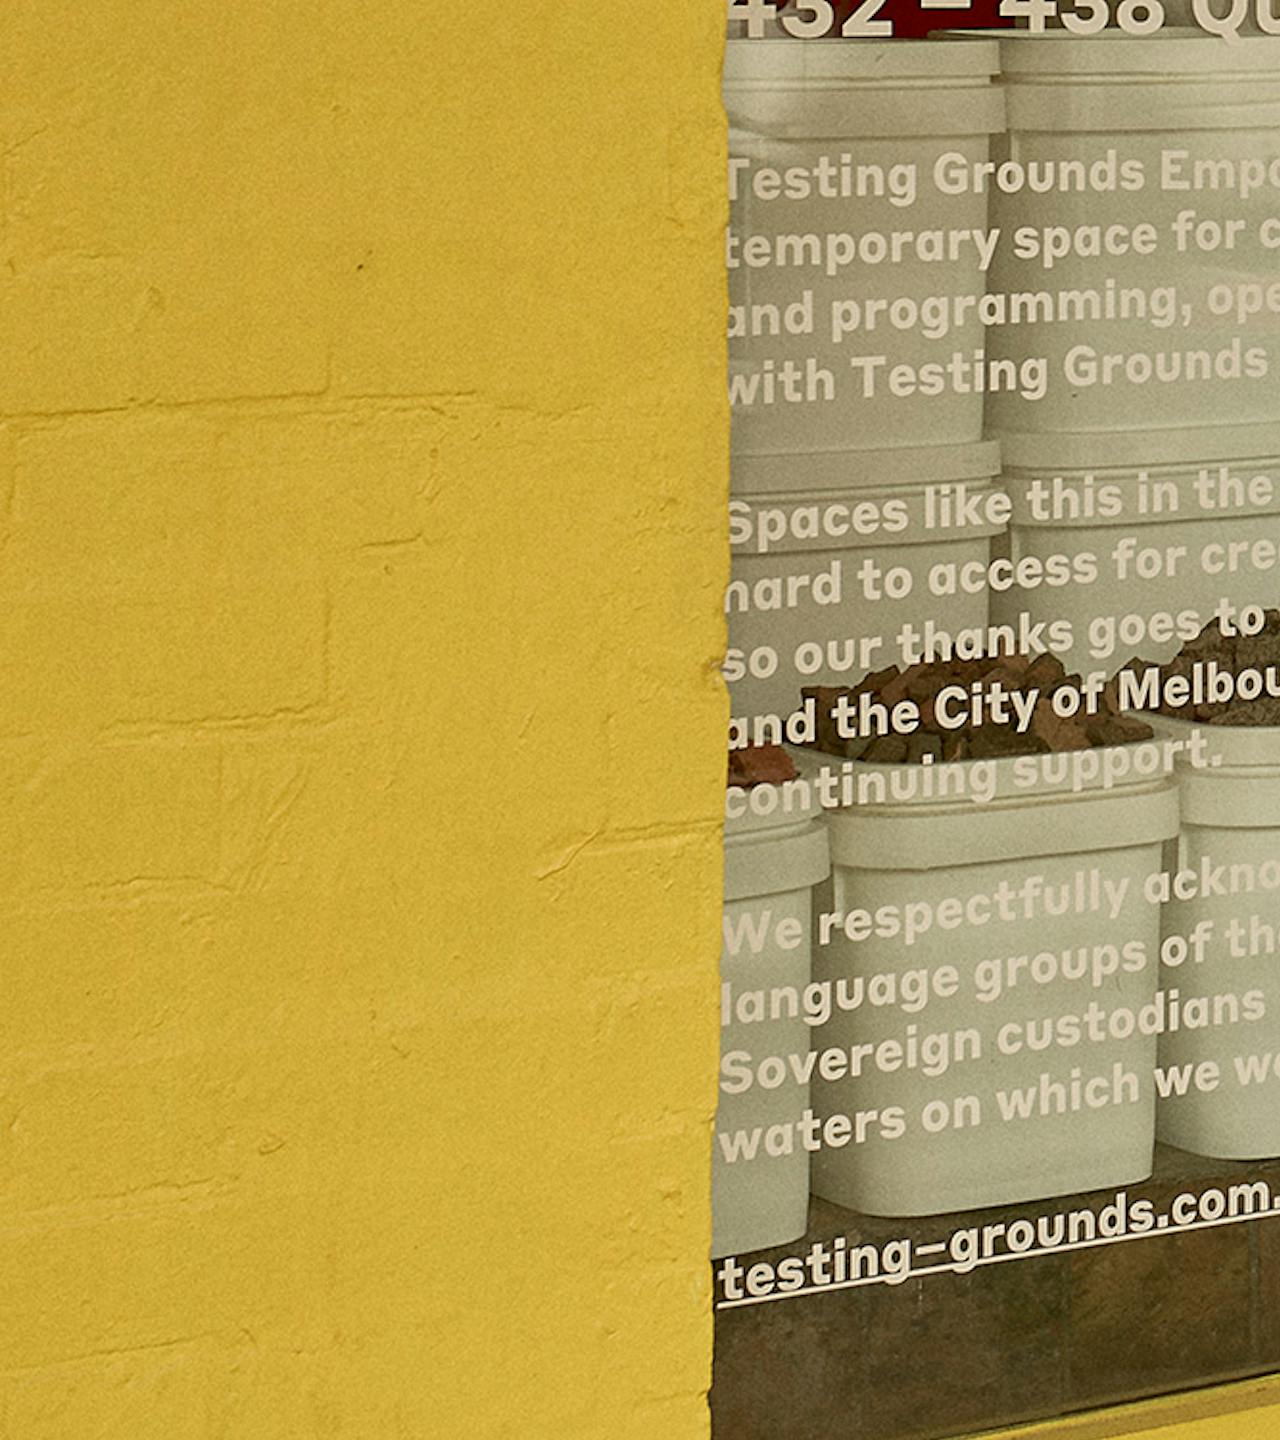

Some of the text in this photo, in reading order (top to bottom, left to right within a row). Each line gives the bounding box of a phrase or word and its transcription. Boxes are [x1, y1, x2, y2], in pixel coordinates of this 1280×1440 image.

[727, 153, 918, 207] Testing
[932, 148, 1146, 198] Grounds
[726, 224, 1000, 276] temporary
[1013, 219, 1158, 268] space
[1174, 210, 1245, 252] for
[727, 290, 814, 339] and
[831, 278, 1193, 342] programming,
[727, 357, 835, 406] with
[850, 349, 1049, 399] Testing
[1063, 336, 1268, 388] Grounds
[728, 497, 909, 553] Spaces
[923, 483, 1013, 530] like
[1026, 474, 1123, 522] this
[1138, 471, 1179, 515] in
[1192, 466, 1274, 511] the
[857, 557, 914, 601] to
[928, 548, 1098, 597] access
[1111, 537, 1187, 582] for
[722, 644, 779, 683] so
[793, 632, 884, 676] our
[896, 611, 1075, 666] thanks
[1087, 606, 1201, 658] goes
[1213, 597, 1266, 638] to
[727, 697, 817, 750] and
[830, 694, 920, 739] the
[934, 680, 1040, 733] City
[1051, 670, 1107, 718] of
[725, 728, 1224, 820] continuing support.
[722, 909, 802, 957] We
[818, 868, 1130, 946] respectfully
[722, 963, 960, 1027] language
[974, 937, 1147, 1003] groups
[1160, 917, 1214, 967] of
[719, 1022, 982, 1095] Sovereign
[998, 986, 1267, 1057] custodians
[717, 1101, 907, 1164] waters
[921, 1092, 982, 1136] on
[996, 1061, 1140, 1122] which
[1152, 1058, 1221, 1100] we
